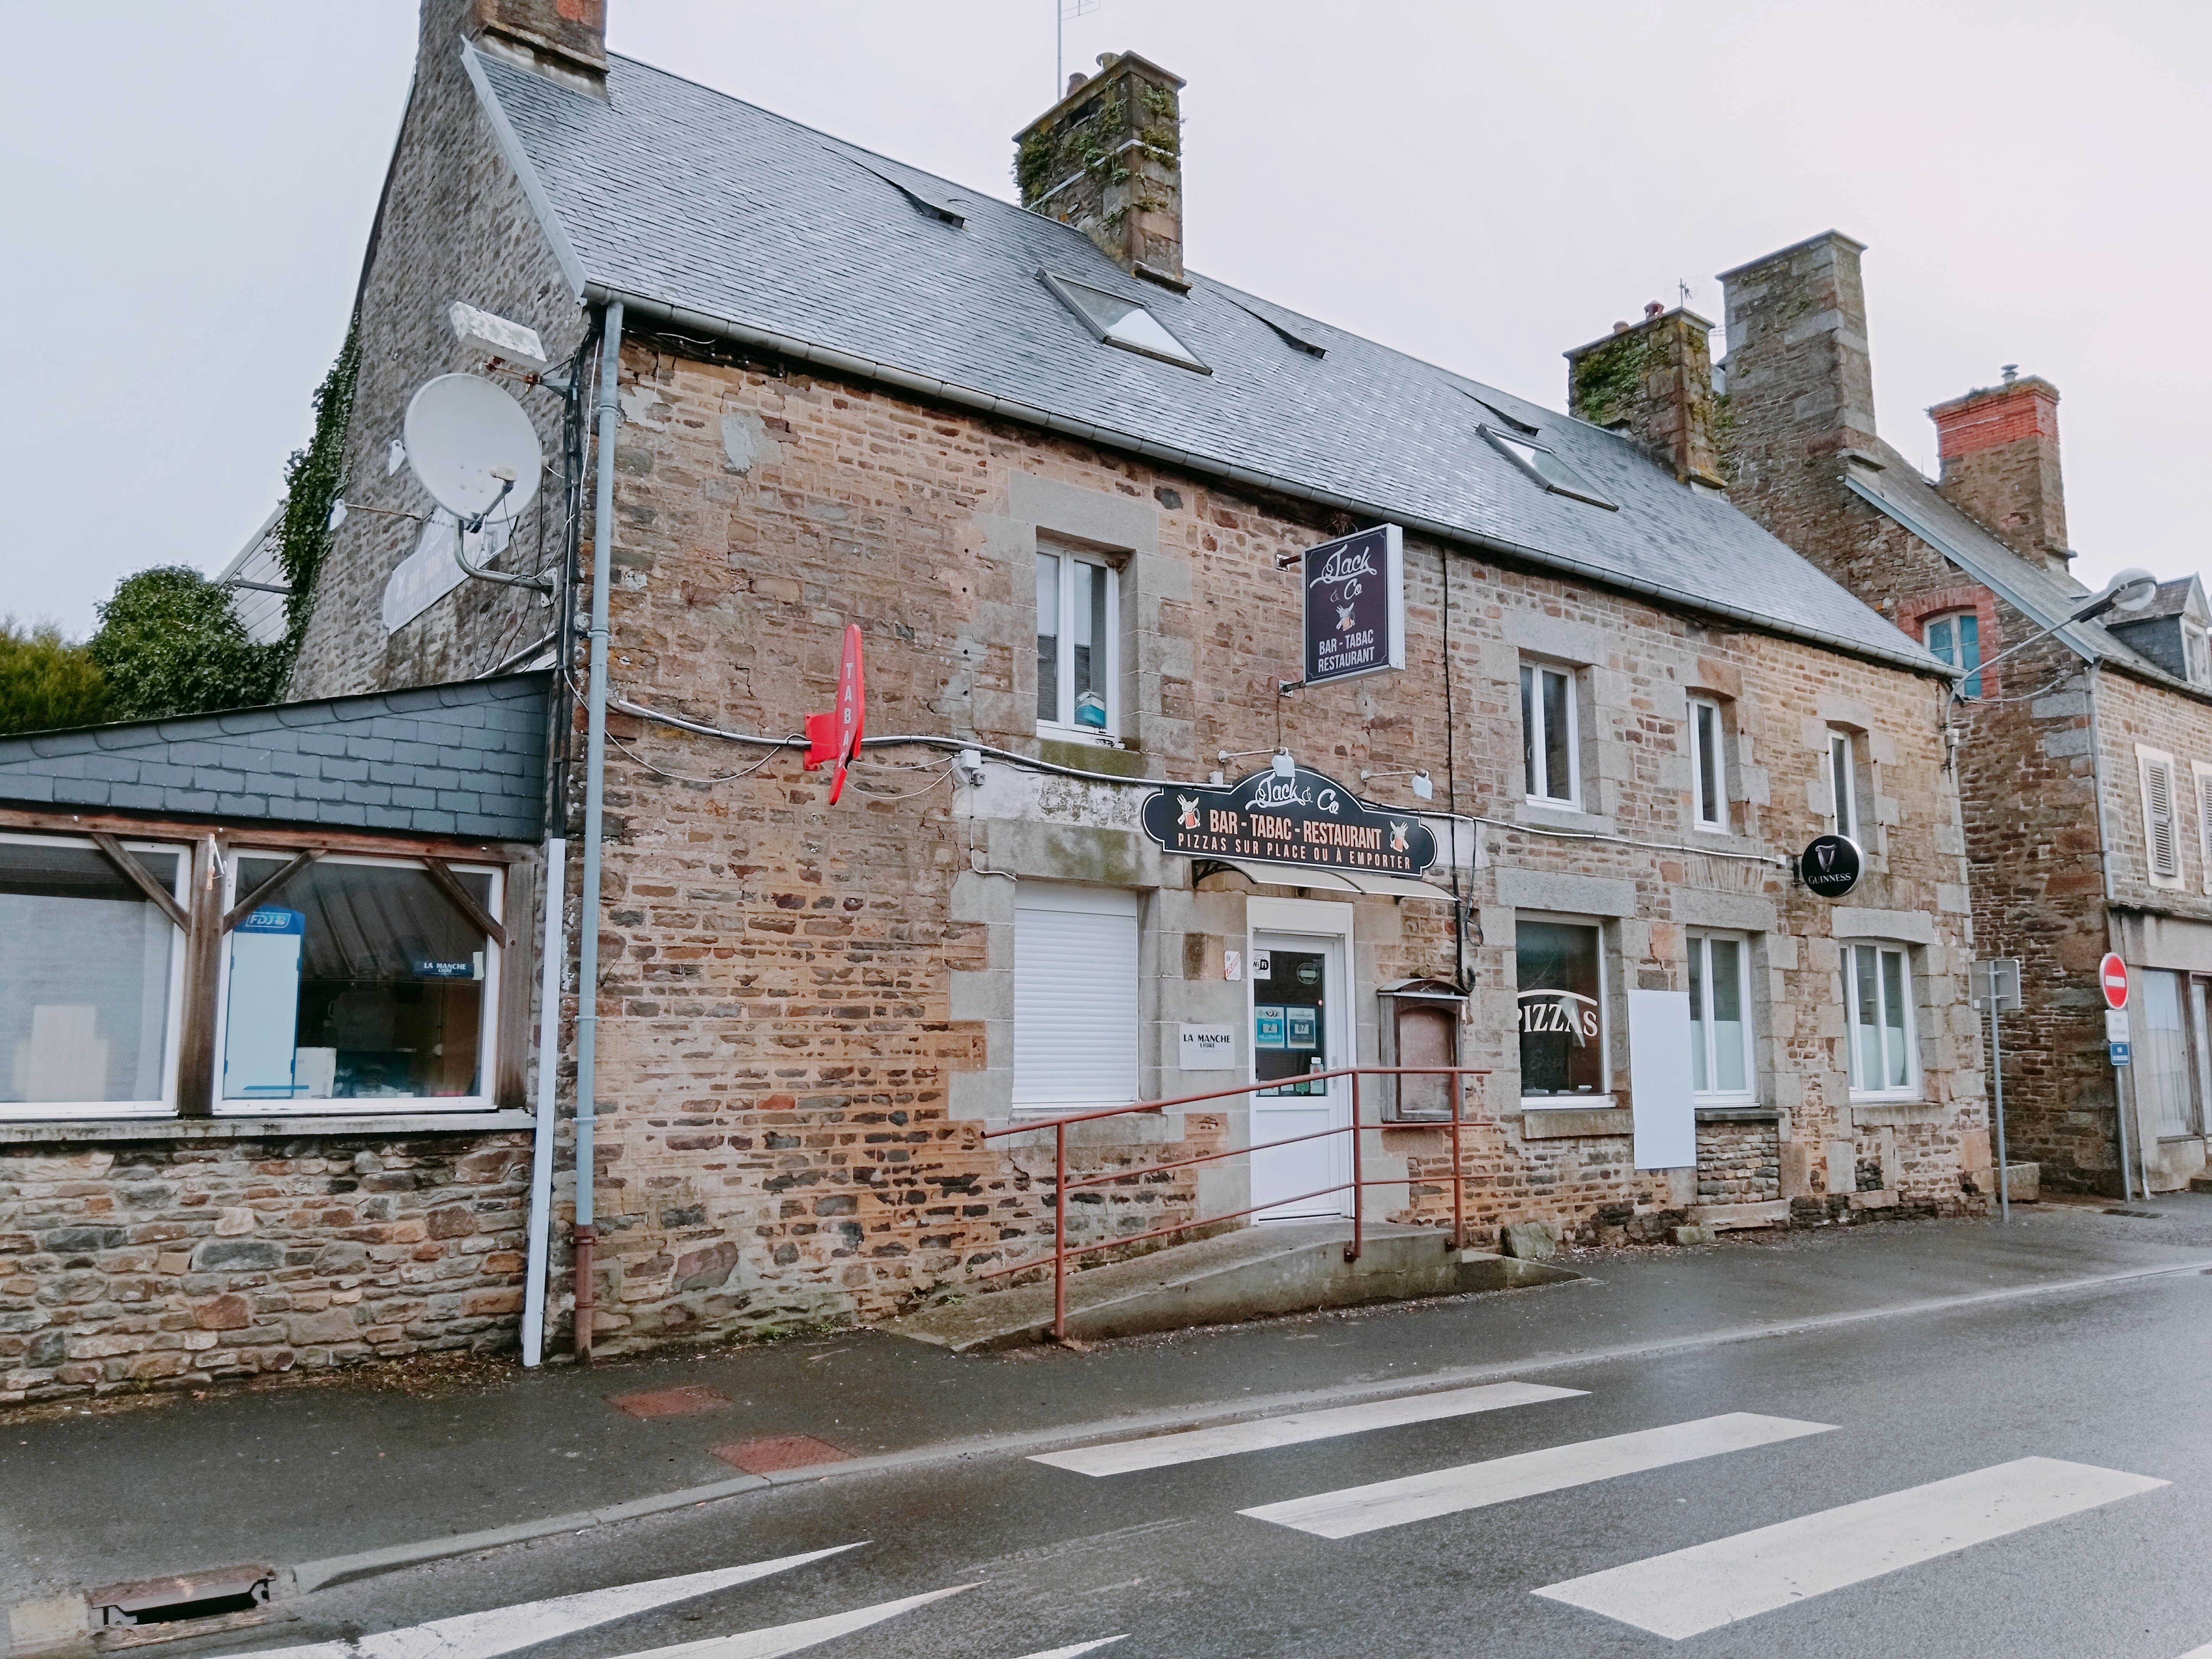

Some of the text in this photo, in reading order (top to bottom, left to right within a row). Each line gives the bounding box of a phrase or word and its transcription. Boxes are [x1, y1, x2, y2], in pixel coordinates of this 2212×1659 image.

[1309, 543, 1377, 589] Jack
[1330, 578, 1363, 602] & Co
[1319, 638, 1337, 655] BAR
[1345, 629, 1373, 649] TABAC
[1318, 646, 1375, 673] RESTAURANT
[838, 662, 853, 771] TABAC
[1245, 771, 1339, 814] Jack & Co
[1210, 809, 1237, 834] BAR
[1250, 813, 1292, 841] TABAC
[1303, 820, 1382, 850] RESTAURANT
[1178, 833, 1410, 870] PIZZAS SUR PLACE OU À EMPORTER
[1808, 873, 1851, 884] GUINNESS
[250, 914, 274, 925] FDJ
[1184, 1034, 1231, 1043] LA MANCHE
